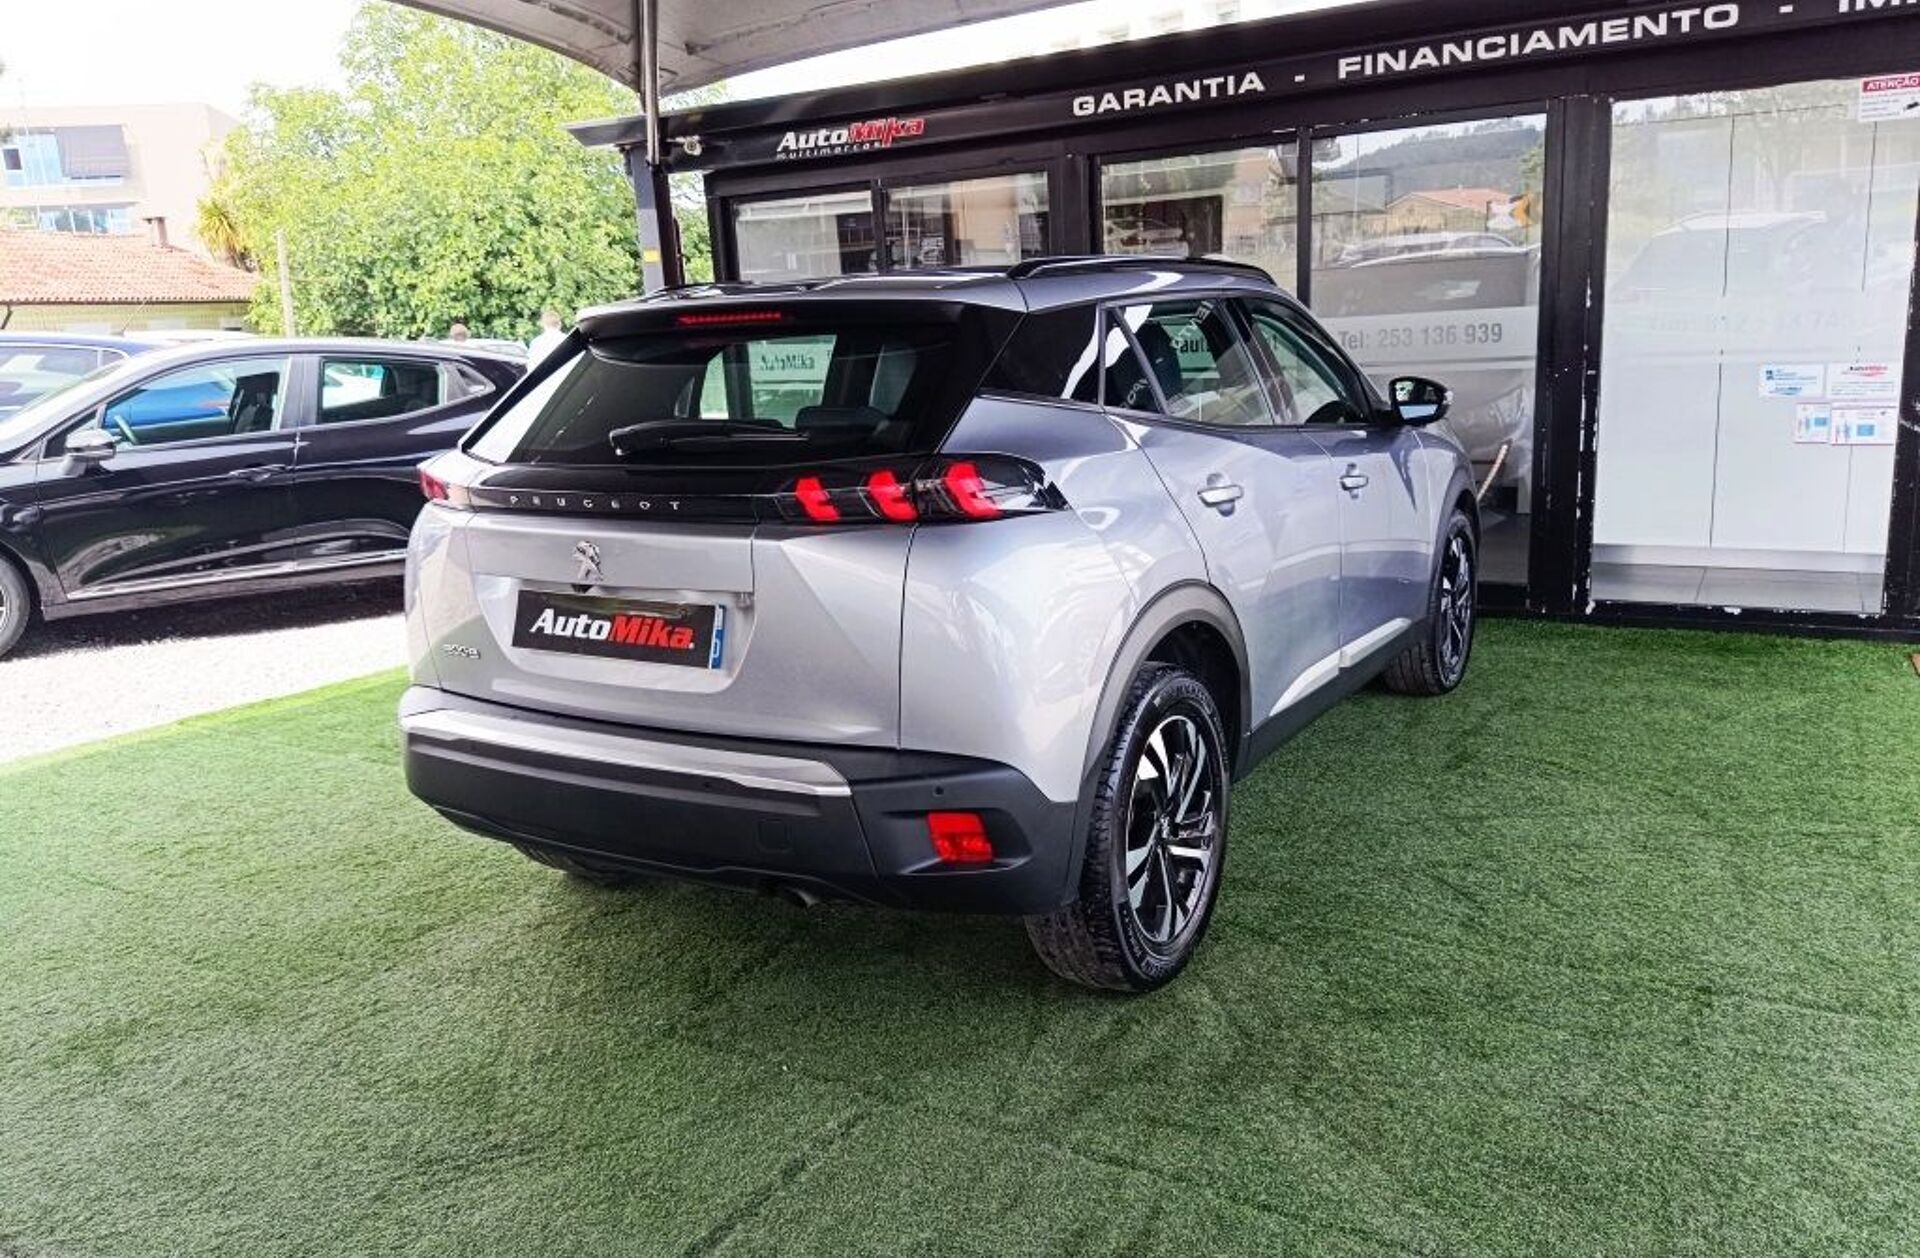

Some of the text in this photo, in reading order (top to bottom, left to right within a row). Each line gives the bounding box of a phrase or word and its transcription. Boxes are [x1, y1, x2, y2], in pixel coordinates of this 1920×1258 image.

[1073, 72, 1265, 116] GARANTIA
[1338, 3, 1739, 79] FINANCIAMENTO
[776, 117, 925, 152] AutoMika
[1338, 322, 1503, 350] Tel: 253 136 939
[510, 495, 680, 511] PEUGEOT
